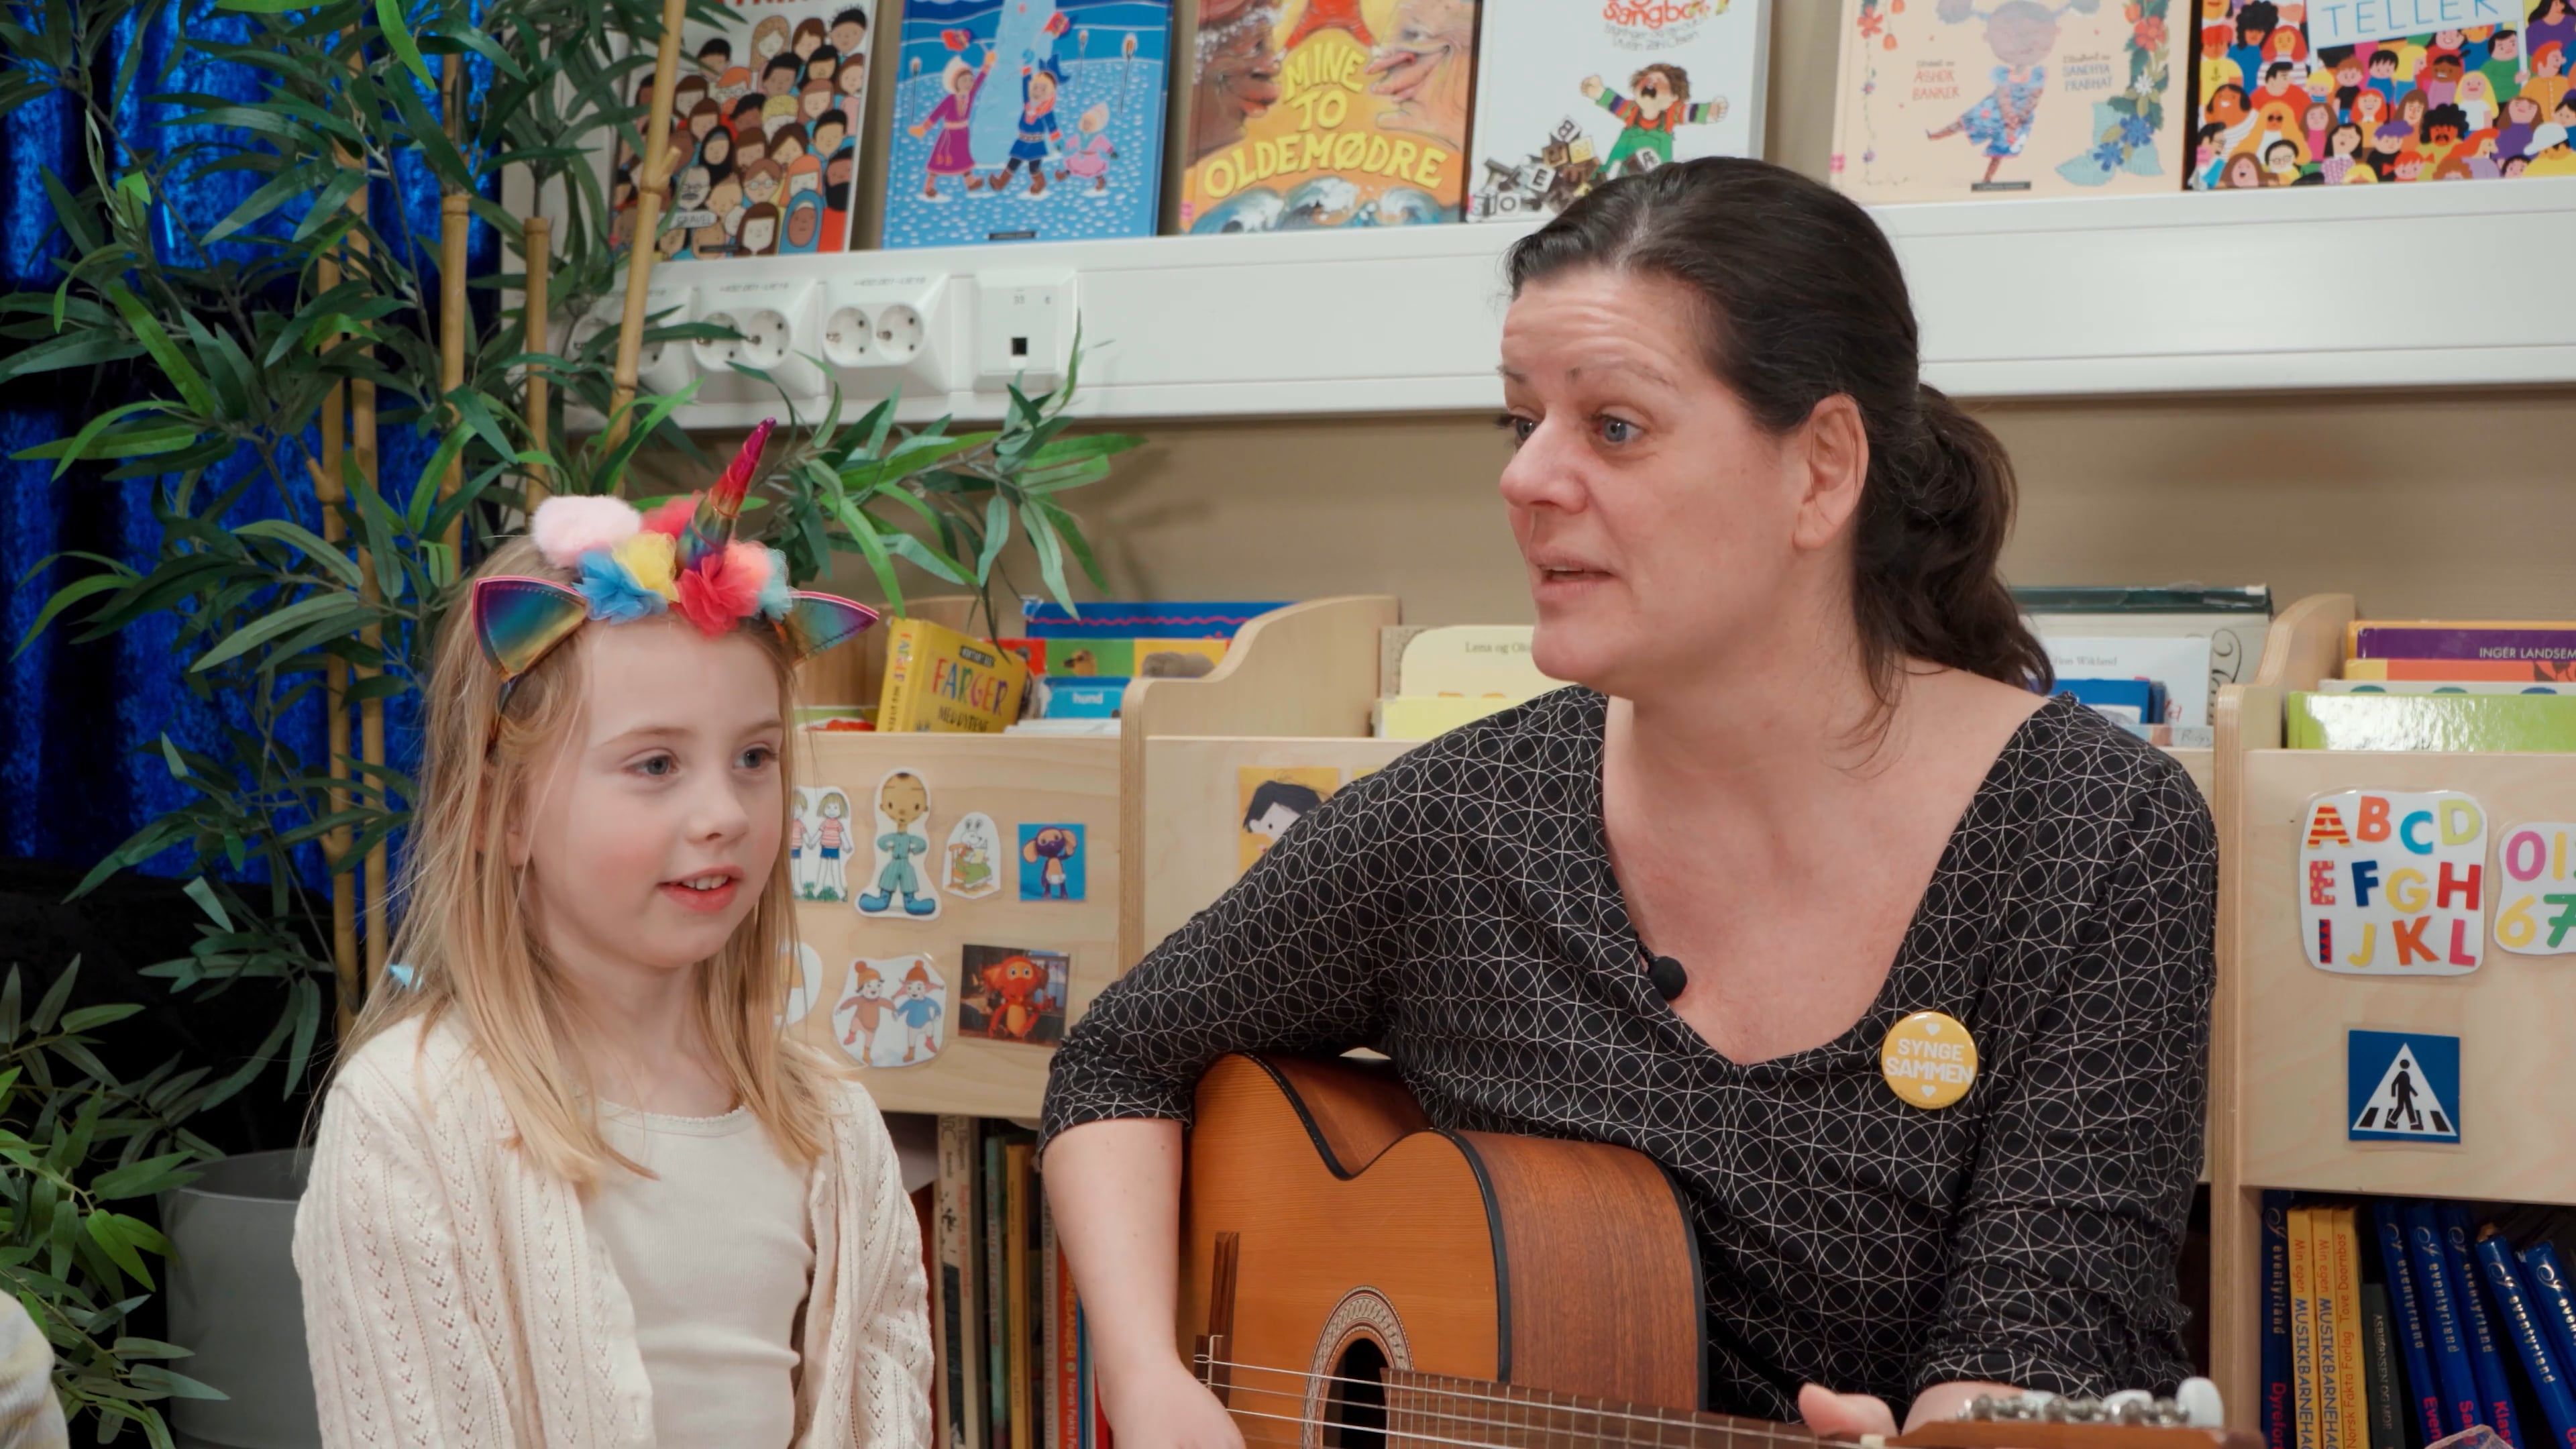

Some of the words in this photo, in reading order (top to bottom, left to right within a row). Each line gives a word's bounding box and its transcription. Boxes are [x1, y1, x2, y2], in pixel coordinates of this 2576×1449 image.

[1283, 42, 1366, 105] MINE
[1291, 89, 1349, 132] TO
[1203, 131, 1448, 199] OLDEMØDRE
[2479, 646, 2516, 659] INGER
[2520, 647, 2576, 659] LANDSEM
[930, 656, 1008, 718] FARGER
[1897, 1038, 1965, 1061] SYNGE
[1885, 1057, 1973, 1084] SAMMEN
[2294, 1239, 2306, 1261] Min
[2318, 1239, 2330, 1261] Min
[2336, 1233, 2349, 1291] Doornbos
[2271, 1245, 2286, 1335] eventyrland
[2292, 1266, 2306, 1293] egen
[2316, 1265, 2330, 1293] egen
[2339, 1295, 2349, 1323] Tove
[2397, 1259, 2426, 1349] eventyrland
[2428, 1262, 2460, 1354] eventyrland
[2463, 1262, 2495, 1354] eventyrland
[2339, 1331, 2355, 1370] Forlag
[2508, 1295, 2557, 1384] eventyrland
[2343, 1373, 2355, 1408] Fakta
[2344, 1411, 2357, 1449] Norsk
